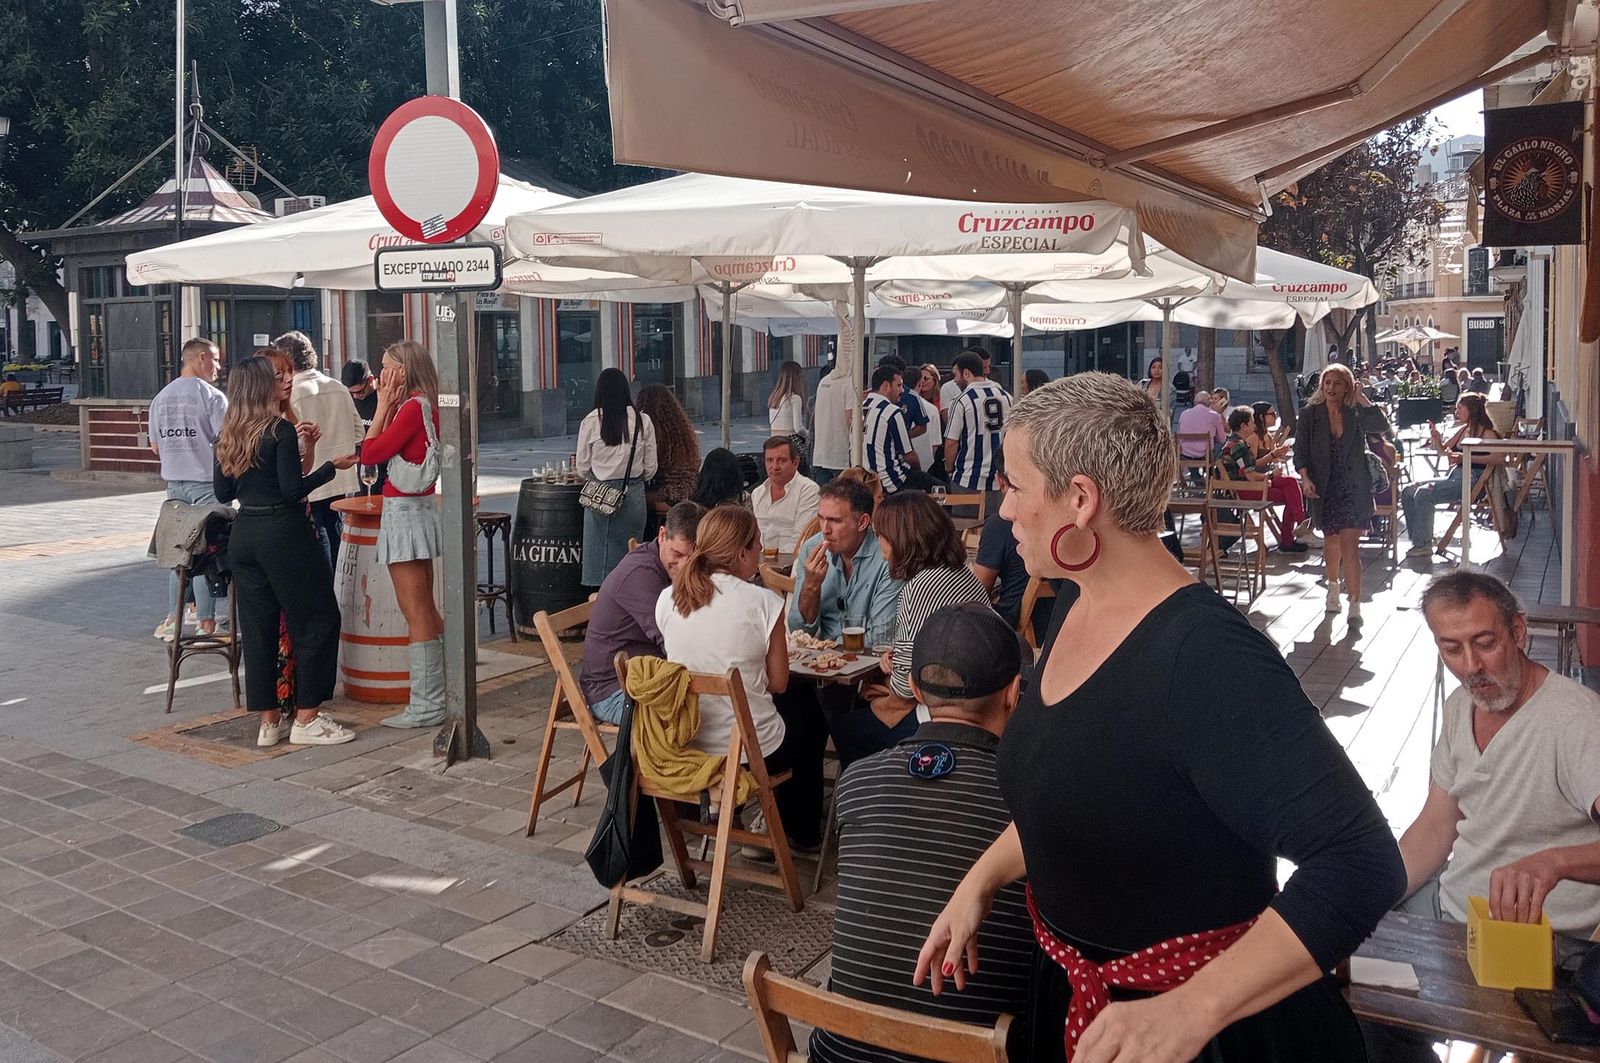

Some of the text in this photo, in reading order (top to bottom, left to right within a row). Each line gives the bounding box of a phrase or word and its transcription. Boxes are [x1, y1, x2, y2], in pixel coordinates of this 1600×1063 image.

[1493, 140, 1574, 171] EL GALLO NEGRO
[1493, 194, 1521, 219] PLAZA
[1539, 188, 1574, 218] MONJAS
[958, 211, 1096, 235] Cruzcampo
[981, 235, 1061, 251] ESPECIAL
[383, 259, 490, 276] EXCEPTO VADO 2344
[1272, 282, 1348, 294] Cruzcampo
[984, 397, 1004, 432] 9
[521, 537, 581, 546] MANZANILLA
[513, 544, 582, 564] LA GITAN
